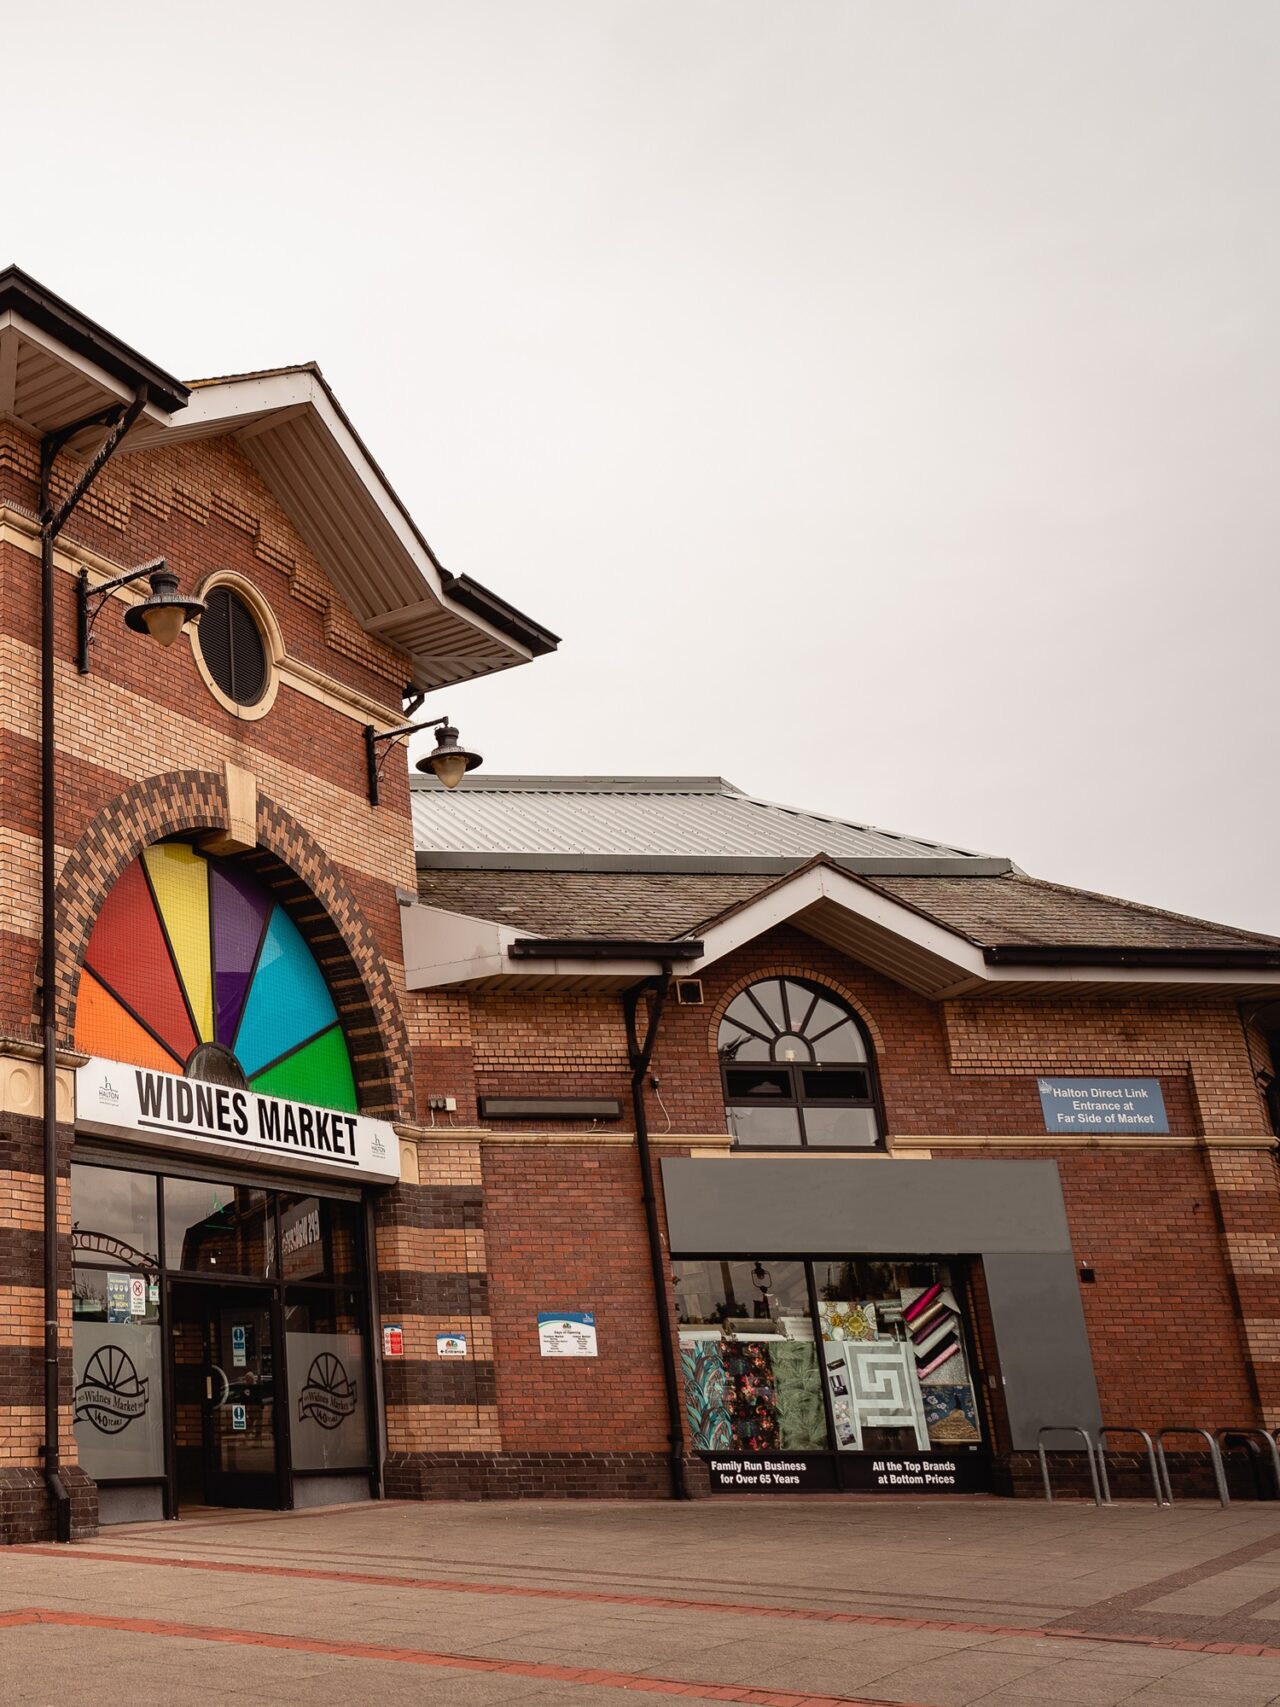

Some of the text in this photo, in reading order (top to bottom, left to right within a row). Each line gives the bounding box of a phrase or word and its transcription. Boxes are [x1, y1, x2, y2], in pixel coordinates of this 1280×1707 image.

[98, 1090, 119, 1100] HALTON
[1053, 1088, 1149, 1098] Halton Direct Link
[1072, 1100, 1135, 1111] Entrance at
[135, 1070, 358, 1157] WIDNES MARKET
[1057, 1113, 1155, 1124] Far Side of Market
[84, 1390, 111, 1406] Widnes
[113, 1394, 137, 1412] Market
[94, 1410, 108, 1427] 140
[711, 1461, 807, 1473] Family Run Business
[872, 1461, 956, 1473] All the Top Brands
[720, 1474, 800, 1484] for Over 65 Years
[878, 1474, 955, 1484] at Bottom Prices
